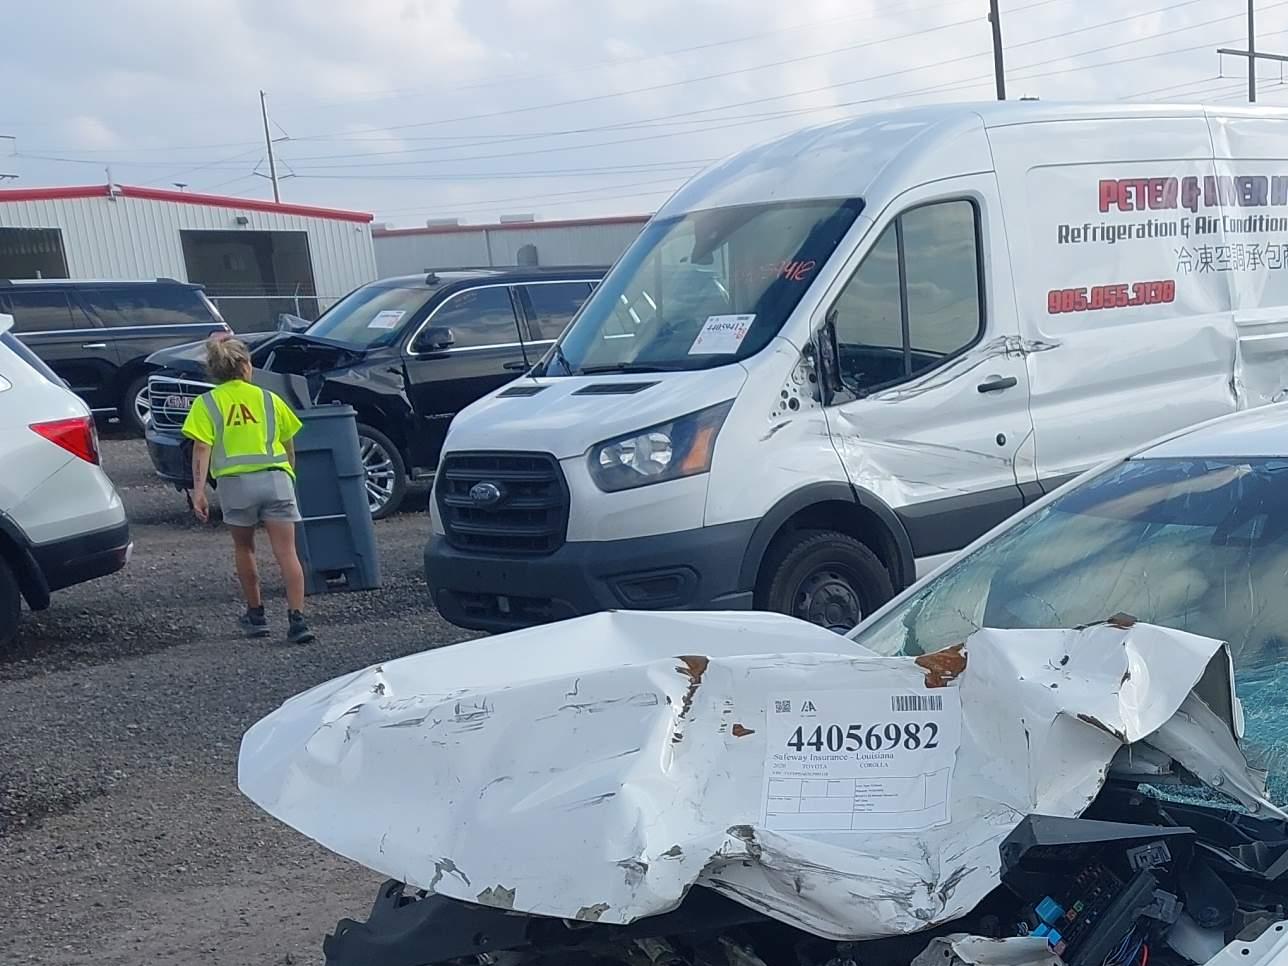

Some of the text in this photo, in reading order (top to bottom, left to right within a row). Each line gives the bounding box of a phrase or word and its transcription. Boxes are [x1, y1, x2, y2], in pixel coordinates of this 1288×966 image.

[1098, 176, 1179, 213] PETER
[1058, 218, 1178, 245] Refrigeration
[1181, 217, 1191, 239] &
[1195, 216, 1221, 235] Air
[787, 722, 940, 752] 44056982
[773, 753, 808, 763] Safeway
[810, 753, 849, 762] Insurance
[856, 752, 895, 761] Louisiana
